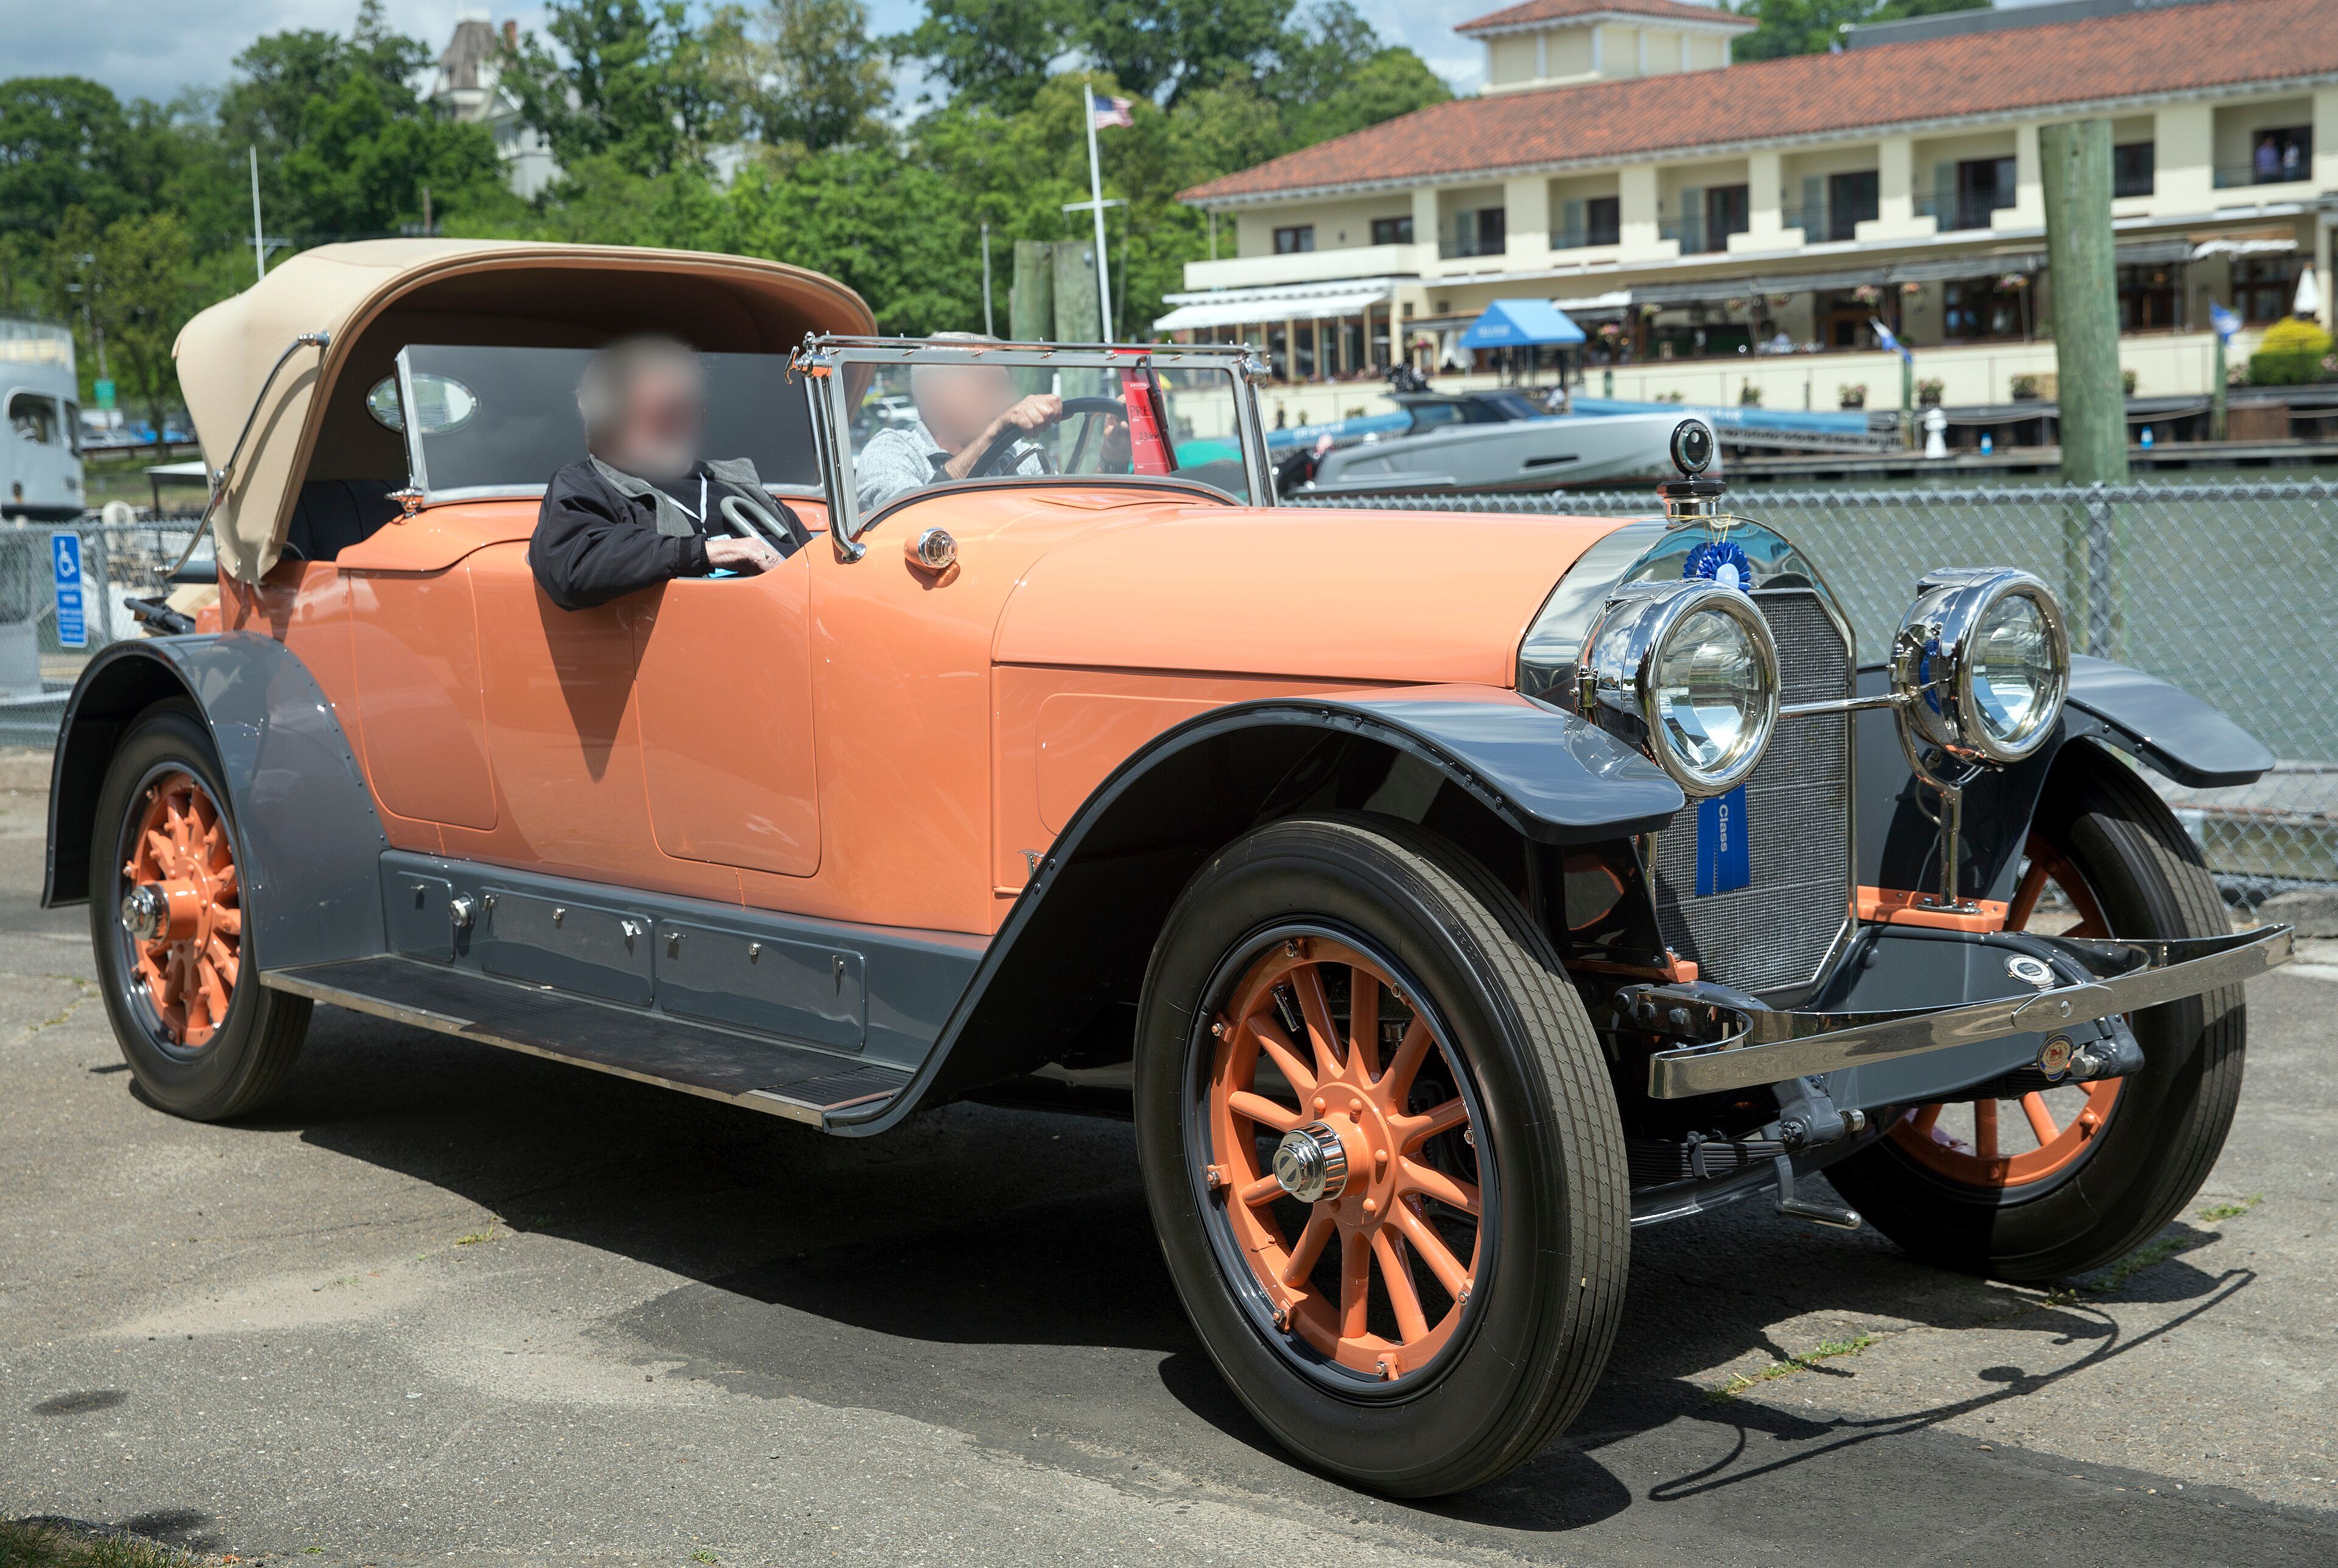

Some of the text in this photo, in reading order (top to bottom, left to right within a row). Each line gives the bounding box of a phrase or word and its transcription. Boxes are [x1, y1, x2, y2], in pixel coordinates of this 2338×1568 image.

[1719, 804, 1729, 852] Class
[1369, 853, 1386, 867] THE
[1393, 875, 1445, 918] LESTER
